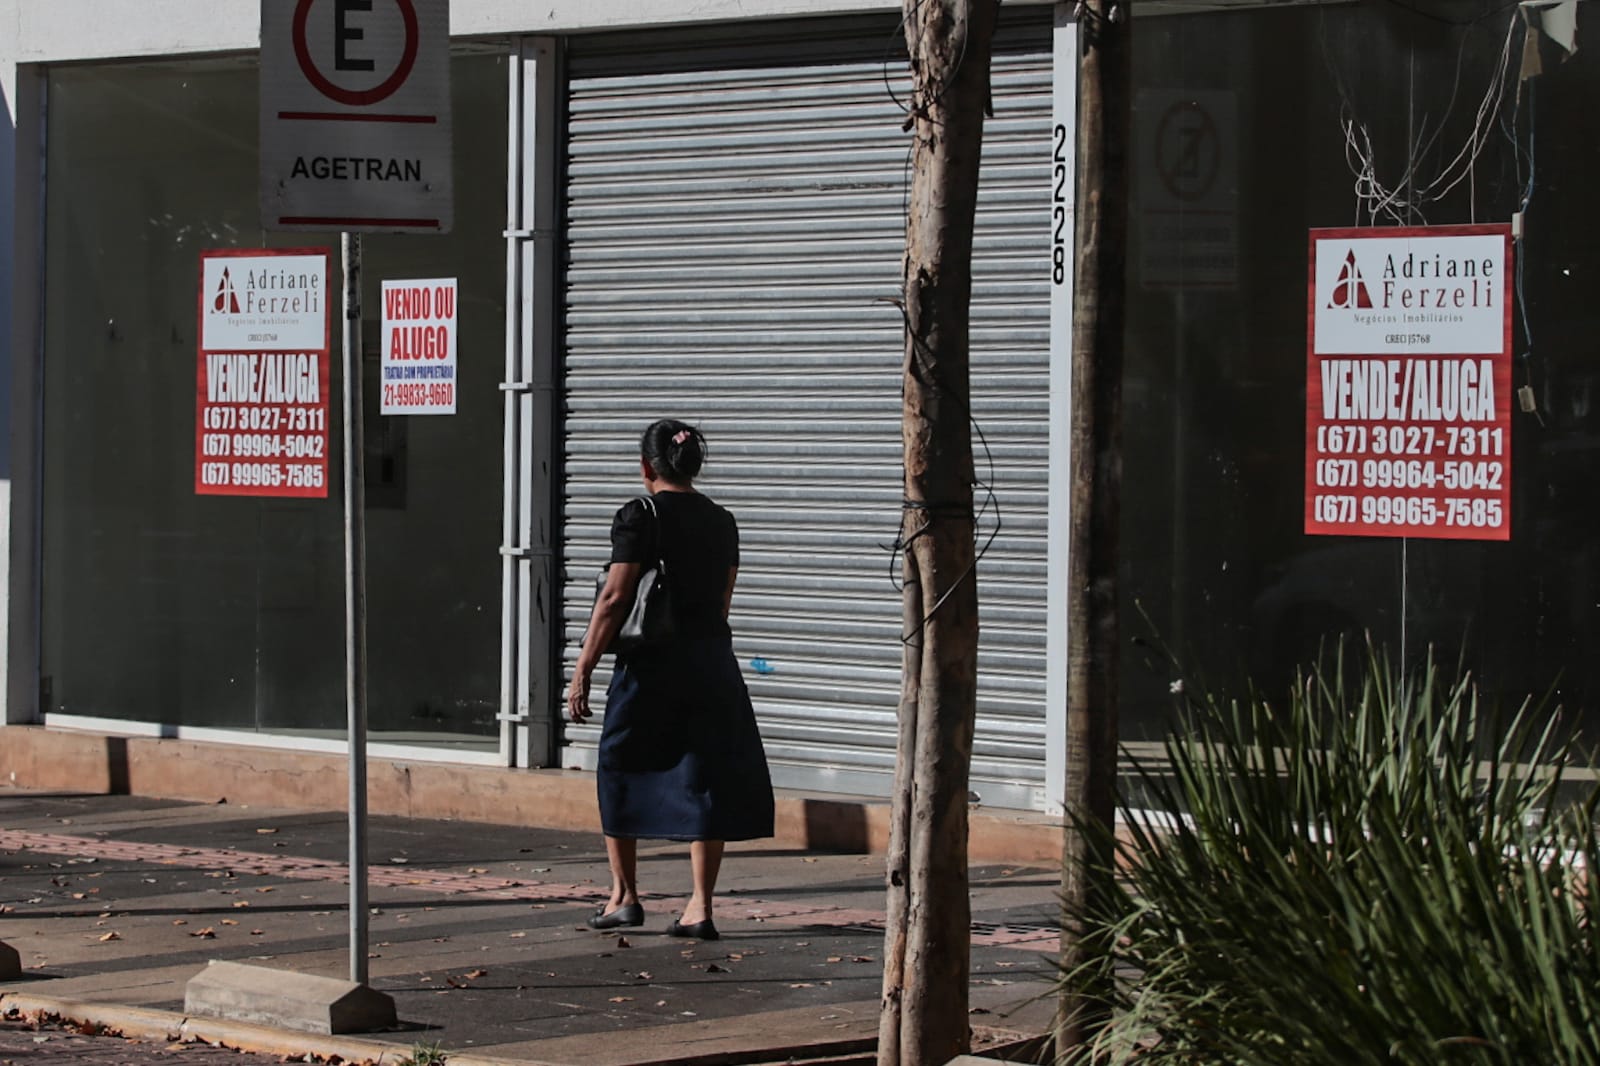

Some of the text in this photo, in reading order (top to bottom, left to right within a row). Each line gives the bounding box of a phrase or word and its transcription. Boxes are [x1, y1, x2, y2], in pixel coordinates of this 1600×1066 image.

[335, 0, 375, 71] E
[291, 156, 421, 181] AGETRAN
[1053, 124, 1066, 285] 2228
[1383, 252, 1493, 278] Adriane
[247, 268, 319, 290] Adriane
[246, 290, 318, 313] Ferzeli
[385, 286, 454, 320] VENDO OU
[1383, 279, 1493, 309] Ferzeli
[1354, 312, 1463, 326] Negócios Imobiliários
[390, 325, 448, 360] ALUGO
[1385, 334, 1407, 344] CRECI
[206, 353, 320, 404] VENDE/ALUGA
[404, 365, 416, 380] COM
[384, 383, 453, 406] 21-99833-9660
[1320, 358, 1496, 422] VENDE/ALUGA
[204, 407, 324, 431] (67) 3027-7311
[203, 433, 323, 458] (67) 99964-5042
[1317, 425, 1503, 455] (67) 3027-7311
[202, 462, 323, 488] (67) 99965-7585
[1316, 459, 1502, 490] (67) 99964-5042
[1314, 495, 1502, 527] (67) 99965-7585
